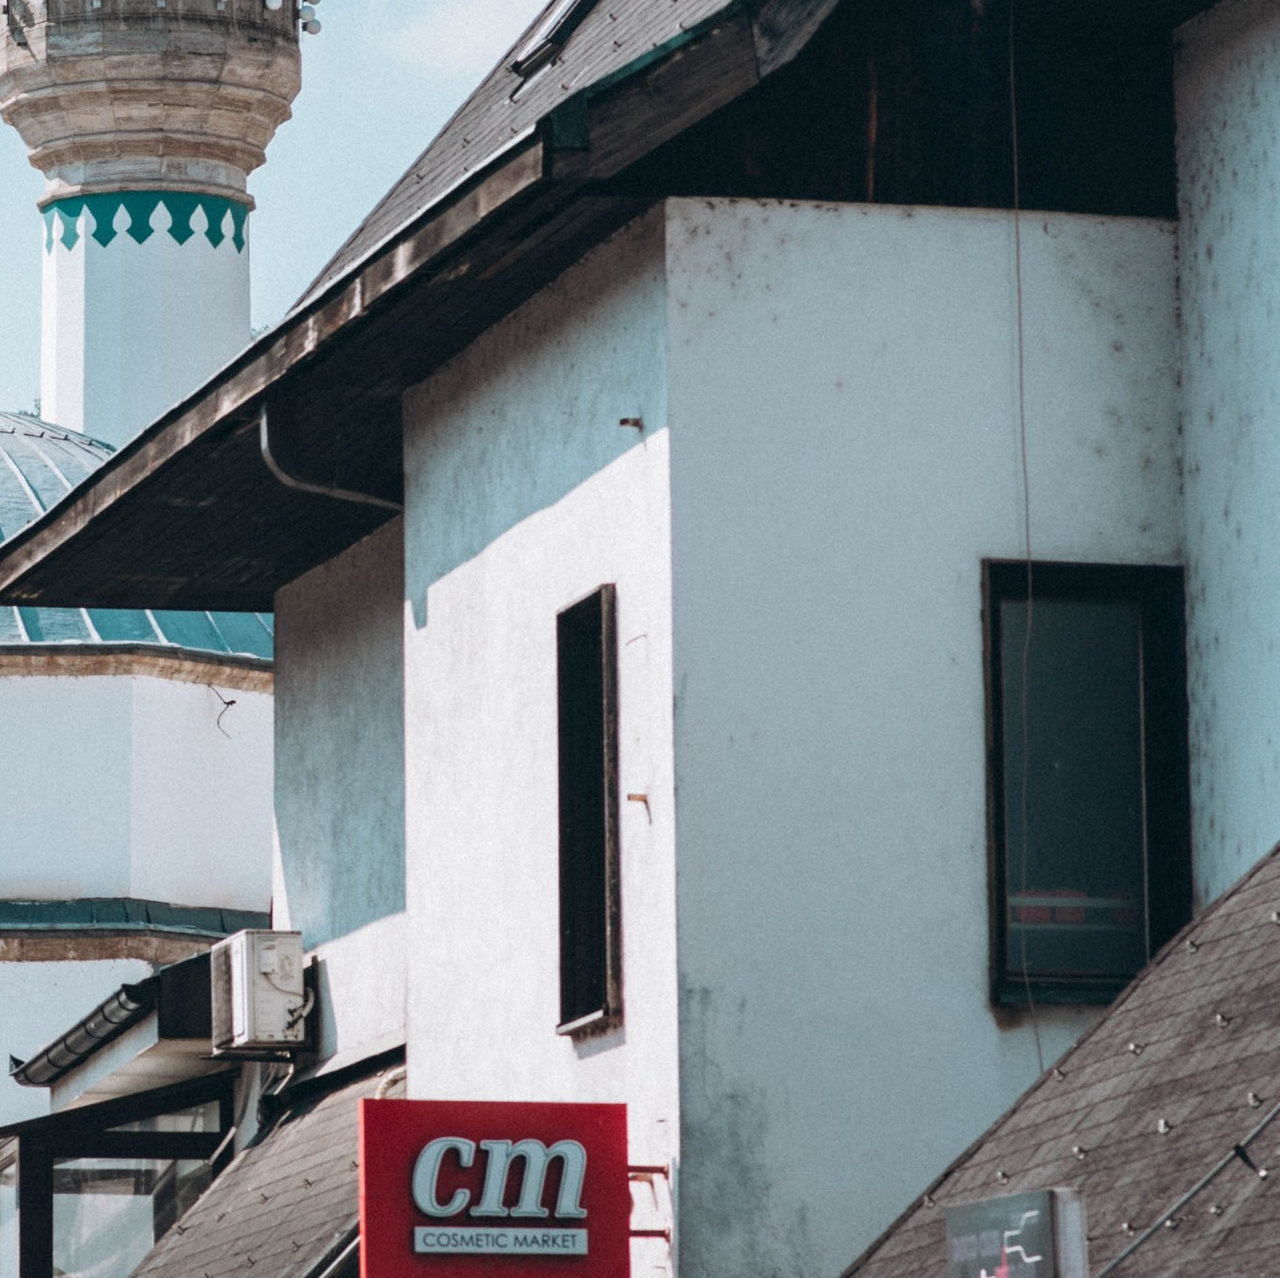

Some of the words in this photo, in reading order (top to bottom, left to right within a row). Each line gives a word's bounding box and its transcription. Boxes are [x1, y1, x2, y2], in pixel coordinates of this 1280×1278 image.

[412, 1137, 587, 1217] cm
[423, 1232, 508, 1248] COSMETIC
[513, 1233, 577, 1249] MARKET
